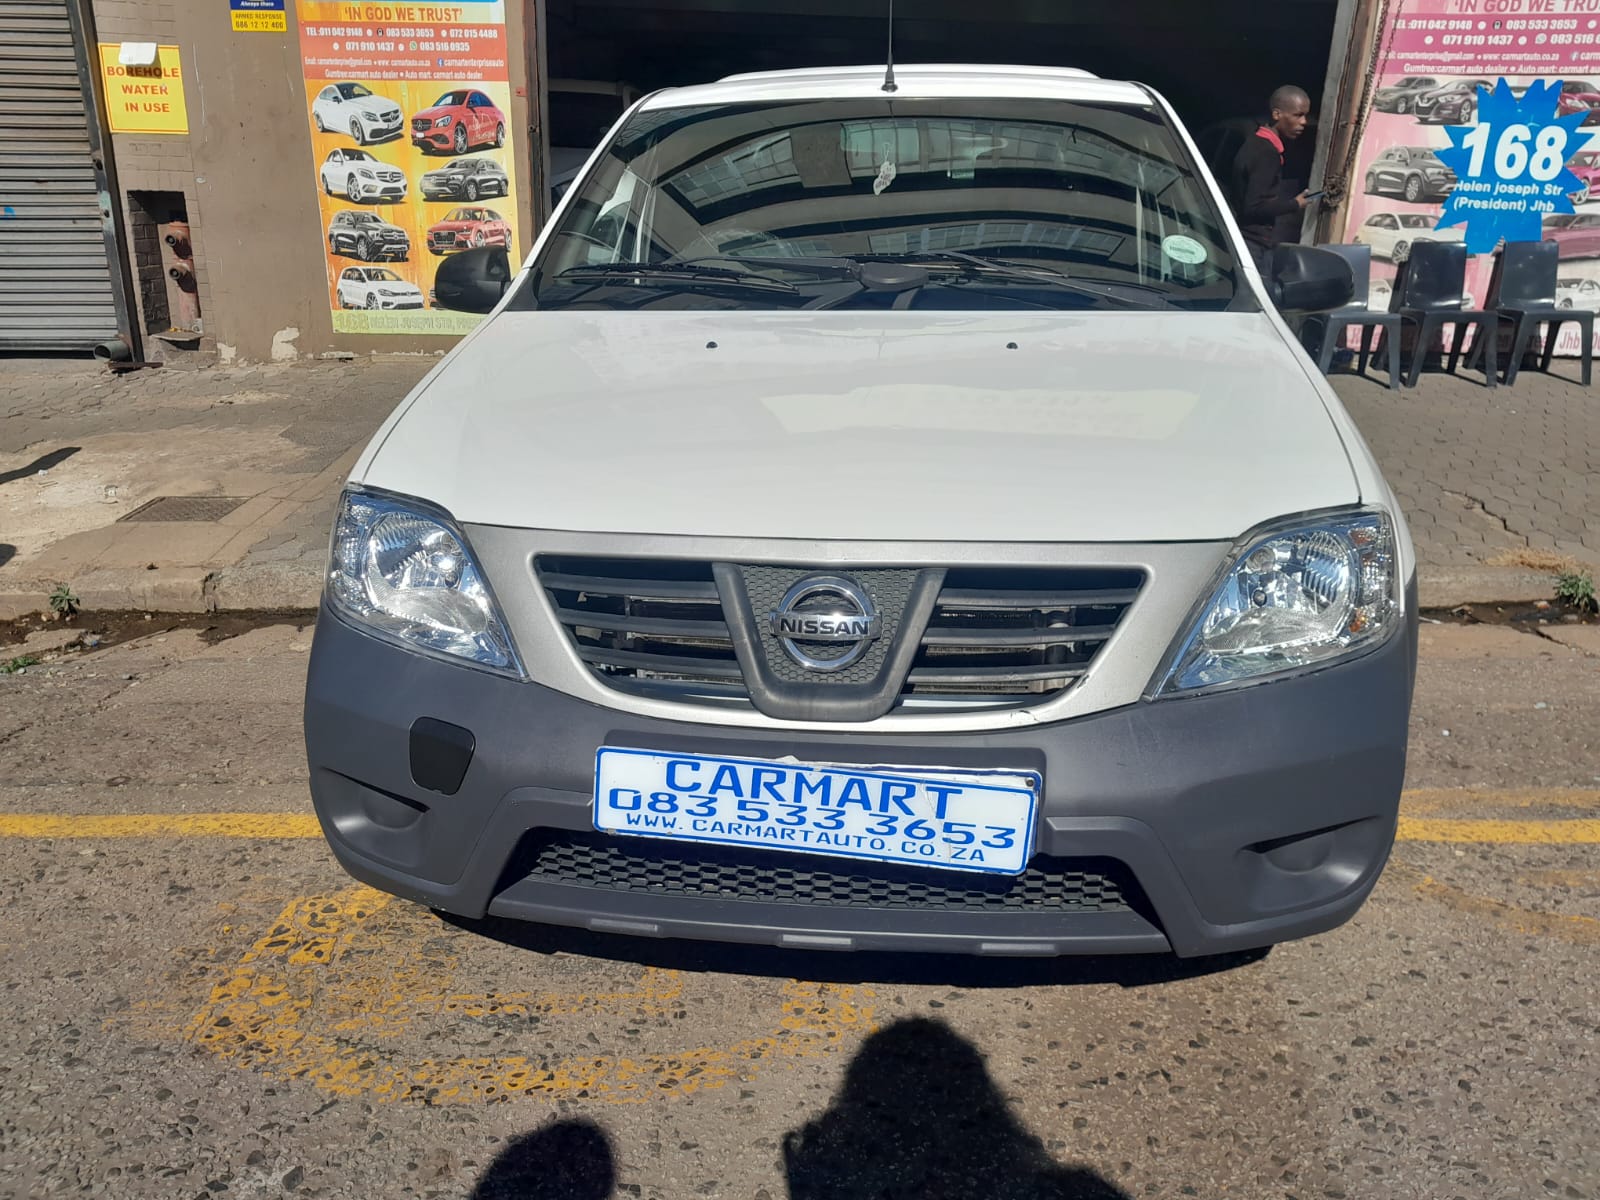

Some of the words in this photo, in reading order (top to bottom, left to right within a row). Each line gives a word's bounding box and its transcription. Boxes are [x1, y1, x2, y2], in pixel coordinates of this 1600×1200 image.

[365, 7, 392, 20] GOD
[395, 7, 415, 20] WE
[1484, 0, 1521, 12] GOD
[1528, 0, 1555, 12] WE
[106, 66, 179, 78] BOREHOLE
[121, 84, 168, 95] WATER
[125, 102, 139, 112] IN
[143, 103, 170, 112] USE
[1462, 122, 1567, 181] 168
[1454, 180, 1491, 193] Helen
[1494, 181, 1540, 197] joseph
[1543, 183, 1564, 196] Str
[1453, 197, 1527, 212] (President)
[1530, 200, 1555, 212] Jhb
[780, 618, 869, 635] NISSAN
[666, 760, 962, 819] CARMART
[609, 788, 717, 817] 083
[737, 800, 846, 830] 533
[865, 812, 1016, 849] 3653
